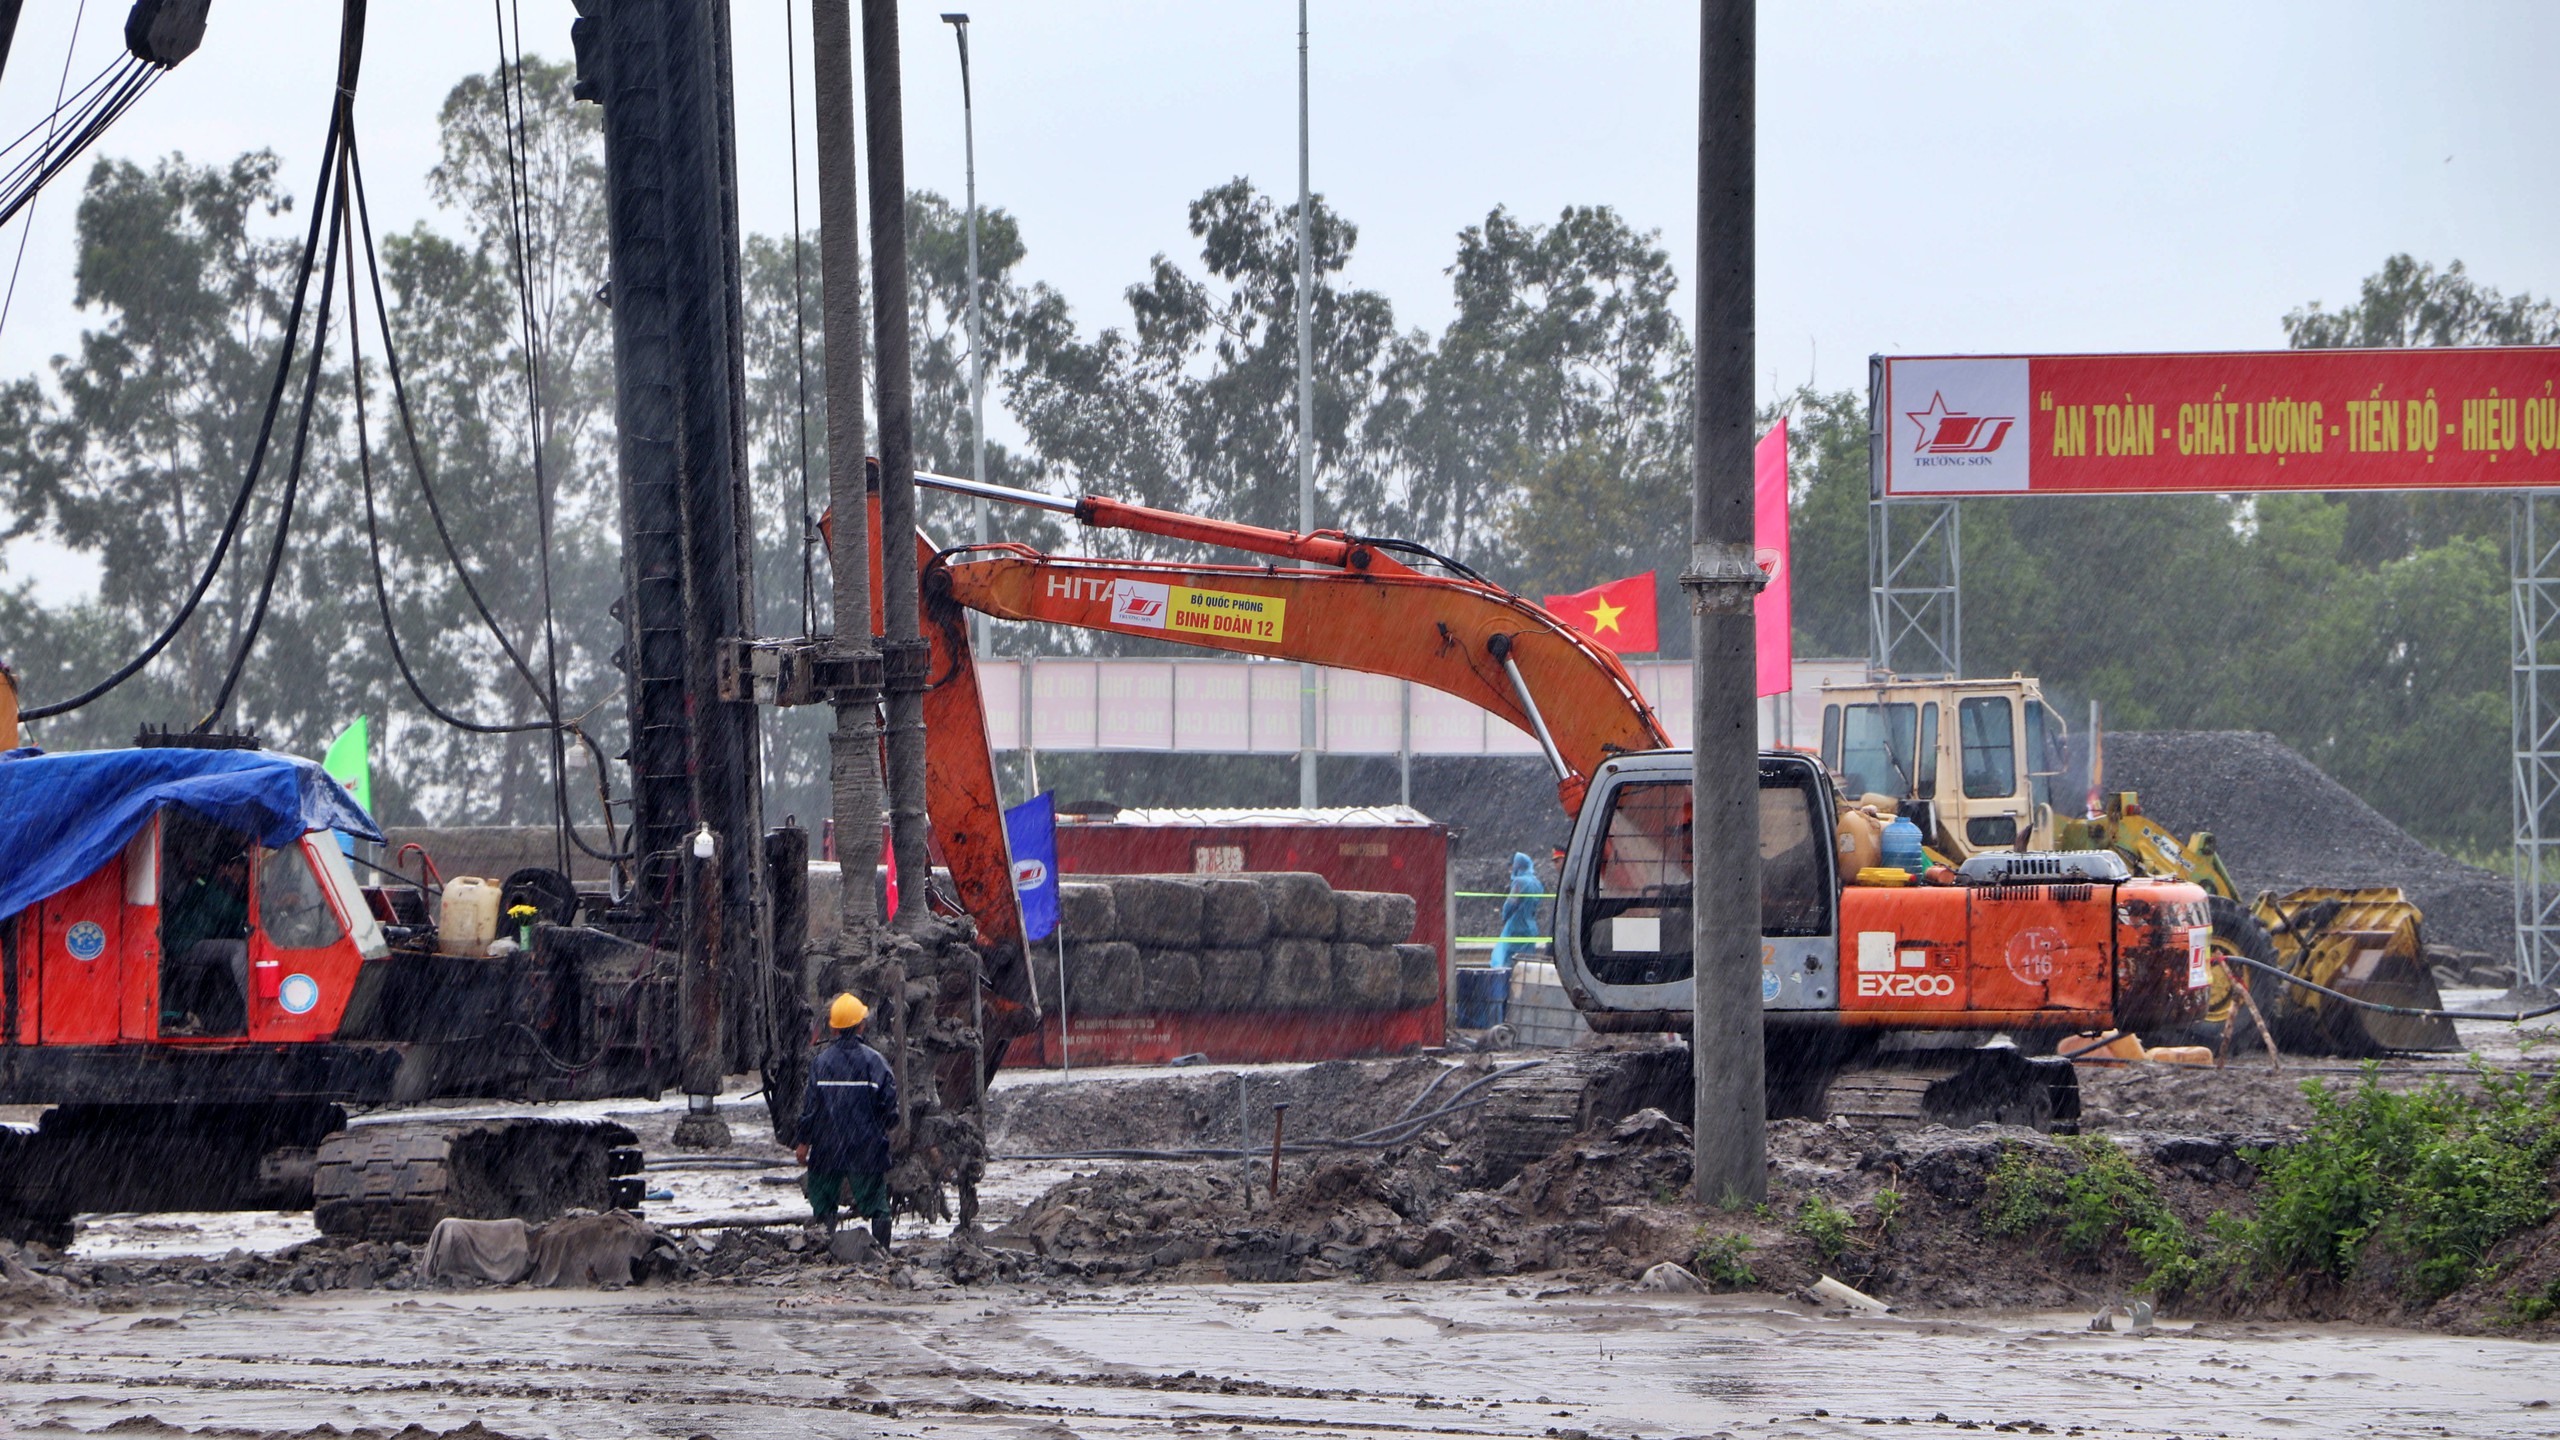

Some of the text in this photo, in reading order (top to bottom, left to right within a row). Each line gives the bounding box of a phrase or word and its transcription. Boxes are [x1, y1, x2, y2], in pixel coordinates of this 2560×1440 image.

[2092, 392, 2155, 456] TOÀN
[2178, 383, 2239, 456] CHẤT
[2245, 396, 2323, 466] LƯỢNG
[2346, 383, 2399, 452] TIẾN
[2406, 388, 2439, 463] ĐỘ
[2462, 387, 2517, 463] HIỆU
[1968, 455, 1993, 466] SƠN
[1190, 593, 1204, 608] BỘ
[1205, 594, 1230, 609] QUỐC
[1176, 610, 1210, 629] BINH
[1257, 620, 1274, 637] 12
[2021, 954, 2053, 976] 116
[1857, 974, 1955, 997] EX200
